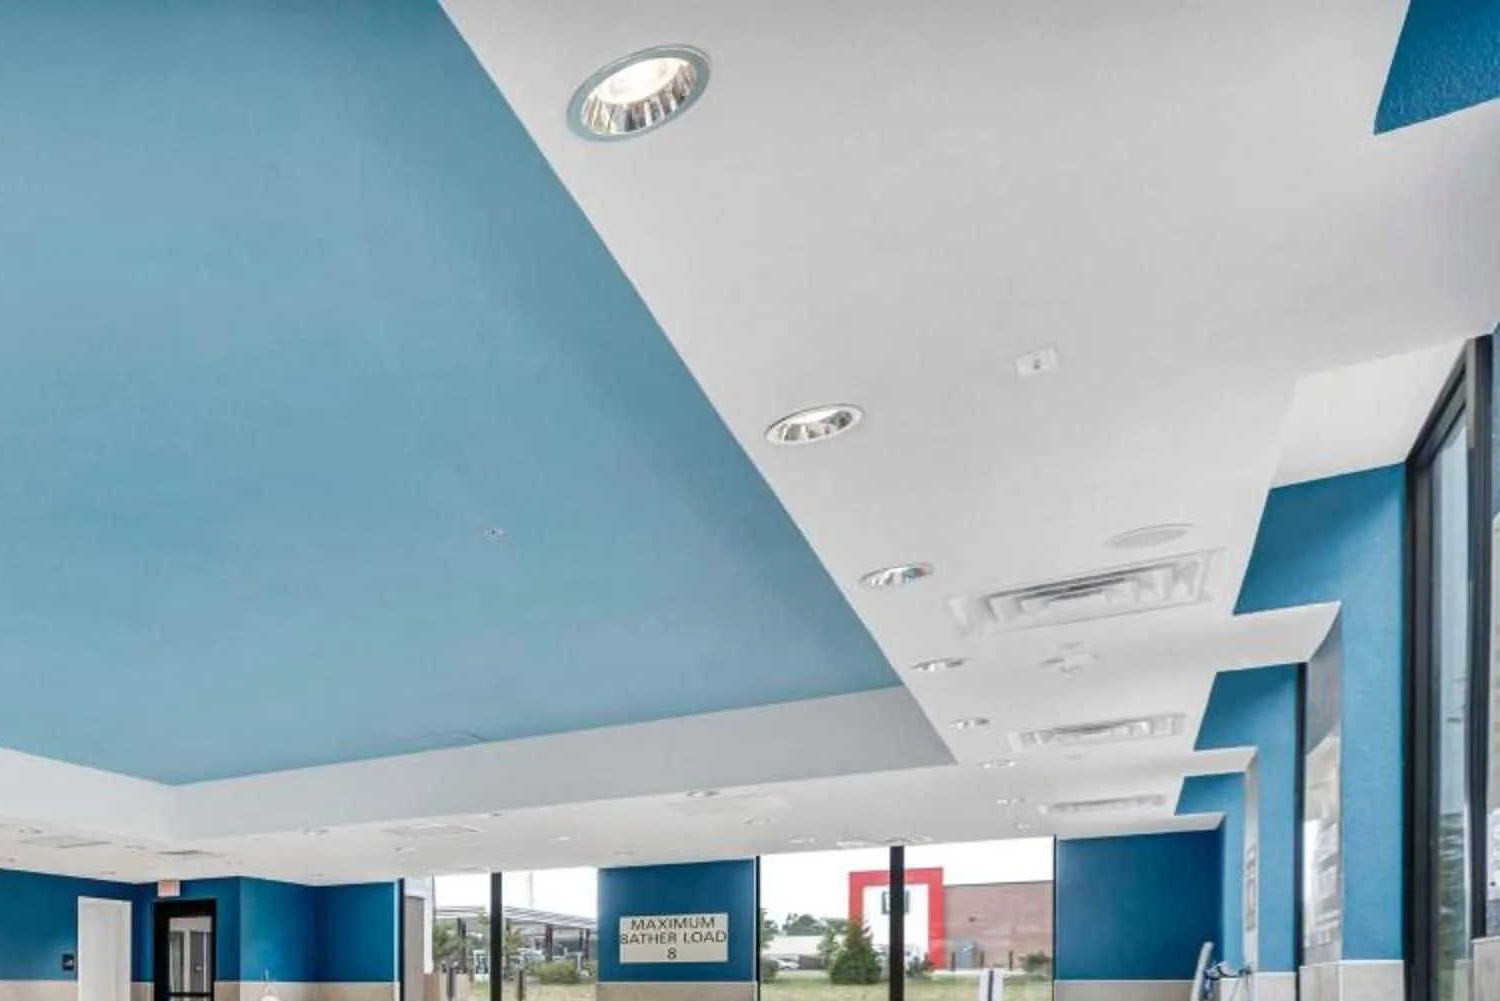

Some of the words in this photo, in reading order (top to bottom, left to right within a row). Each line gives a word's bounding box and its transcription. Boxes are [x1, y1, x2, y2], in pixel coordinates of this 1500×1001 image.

[631, 916, 715, 930] MAXIMUM
[620, 932, 677, 945] BATHER
[683, 929, 726, 945] LOAD
[667, 947, 677, 960] 8
